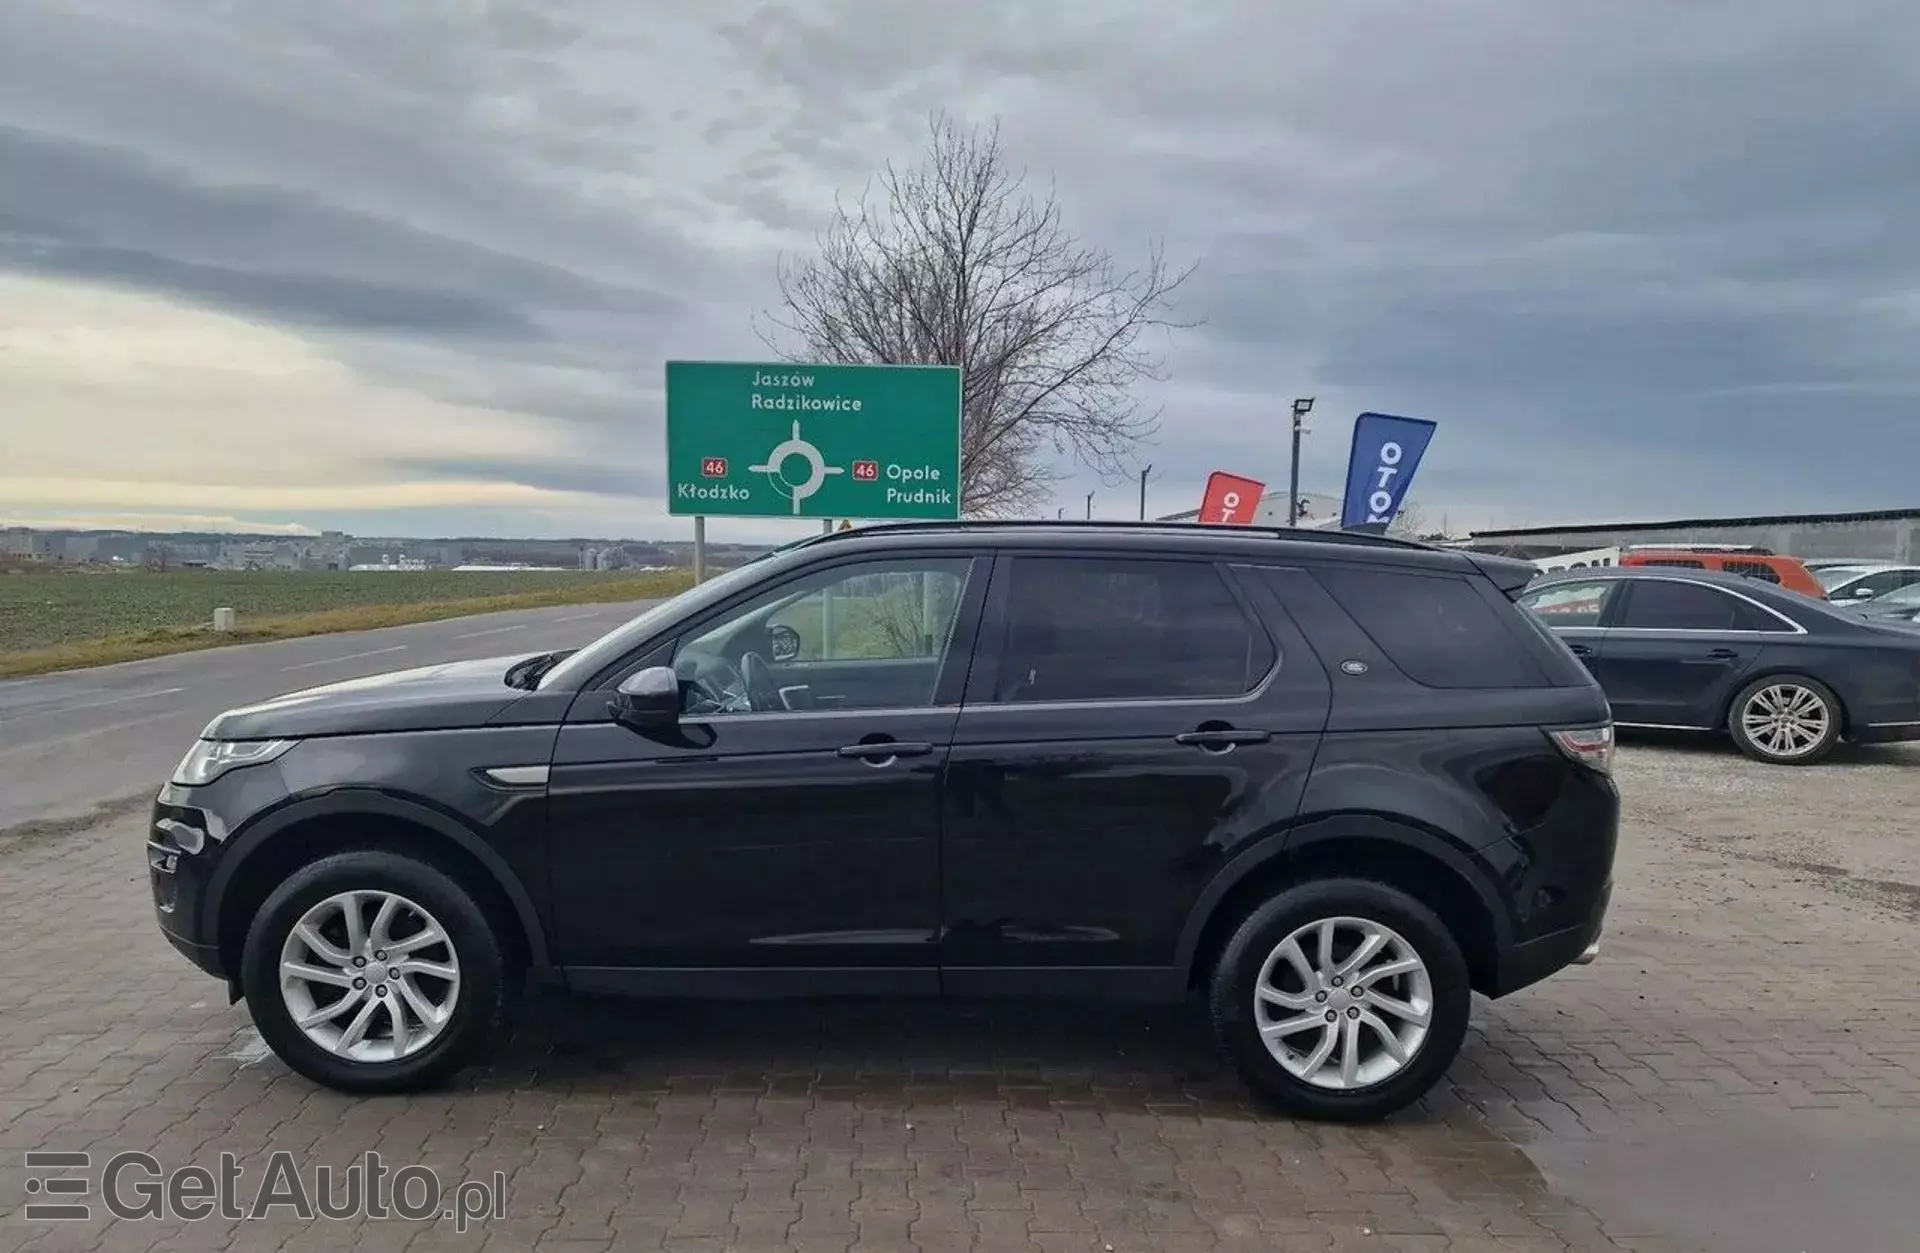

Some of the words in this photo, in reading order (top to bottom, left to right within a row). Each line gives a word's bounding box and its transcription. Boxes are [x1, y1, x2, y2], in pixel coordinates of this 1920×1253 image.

[752, 371, 815, 388] Jaszów
[751, 394, 862, 412] Radzikowice
[705, 462, 725, 475] 46
[855, 464, 876, 478] 46
[886, 465, 941, 481] Opole
[677, 483, 750, 501] Kłodzko
[886, 488, 951, 505] Prudnik
